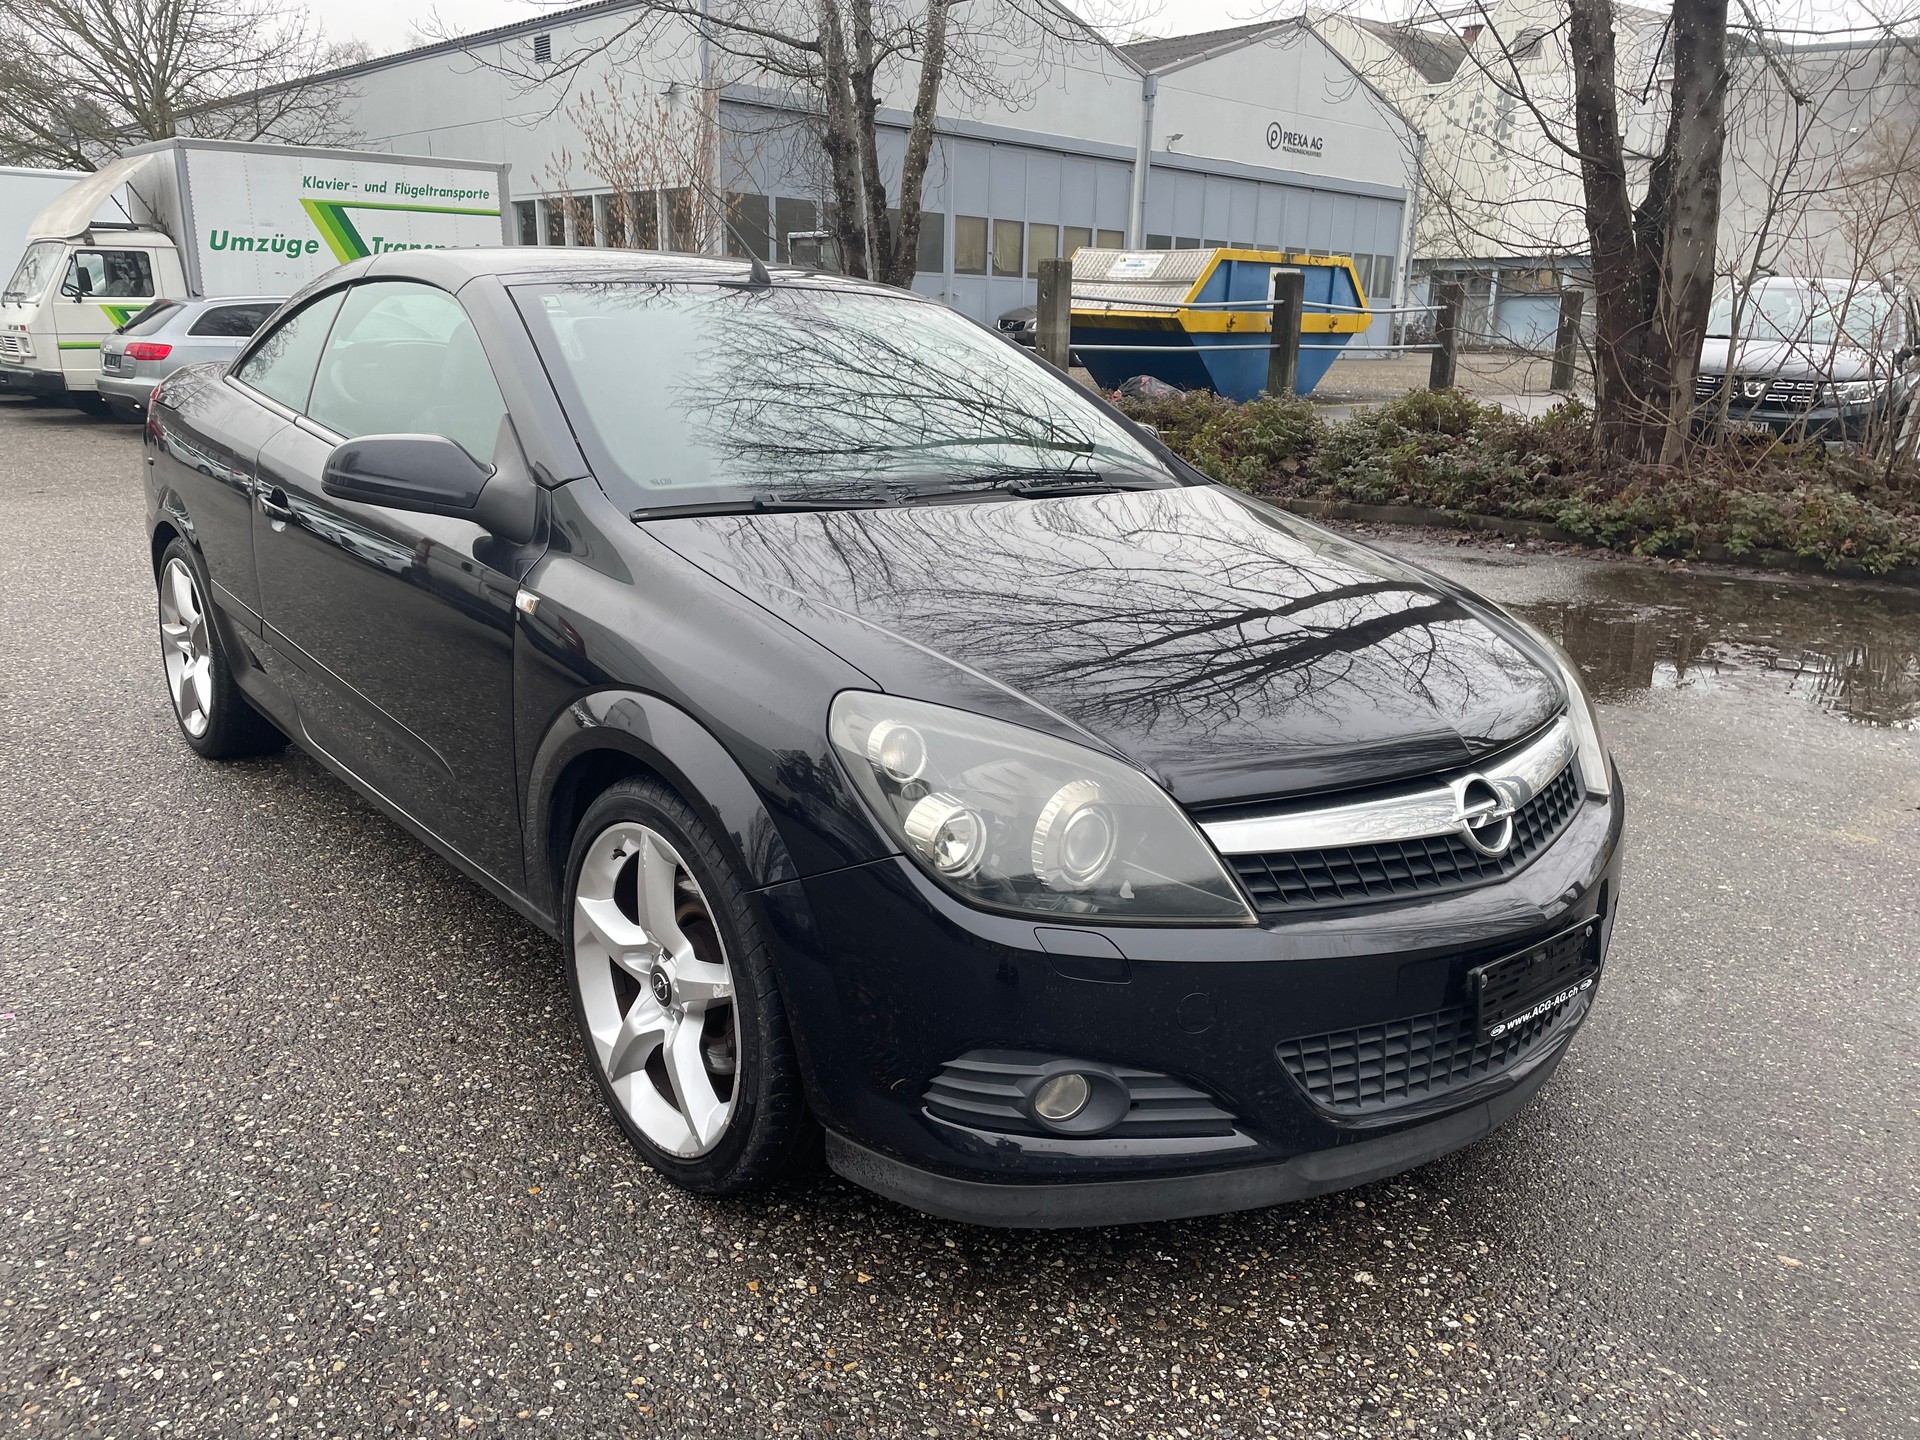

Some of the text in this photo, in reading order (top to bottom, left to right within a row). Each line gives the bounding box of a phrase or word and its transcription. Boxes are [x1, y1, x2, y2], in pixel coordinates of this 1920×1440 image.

[1283, 131, 1323, 150] PREXA AG
[364, 180, 387, 193] und
[394, 181, 490, 202] Flügeltransporte
[209, 229, 320, 259] Umzüge
[1506, 985, 1579, 1030] www.ACG-AG.ch
